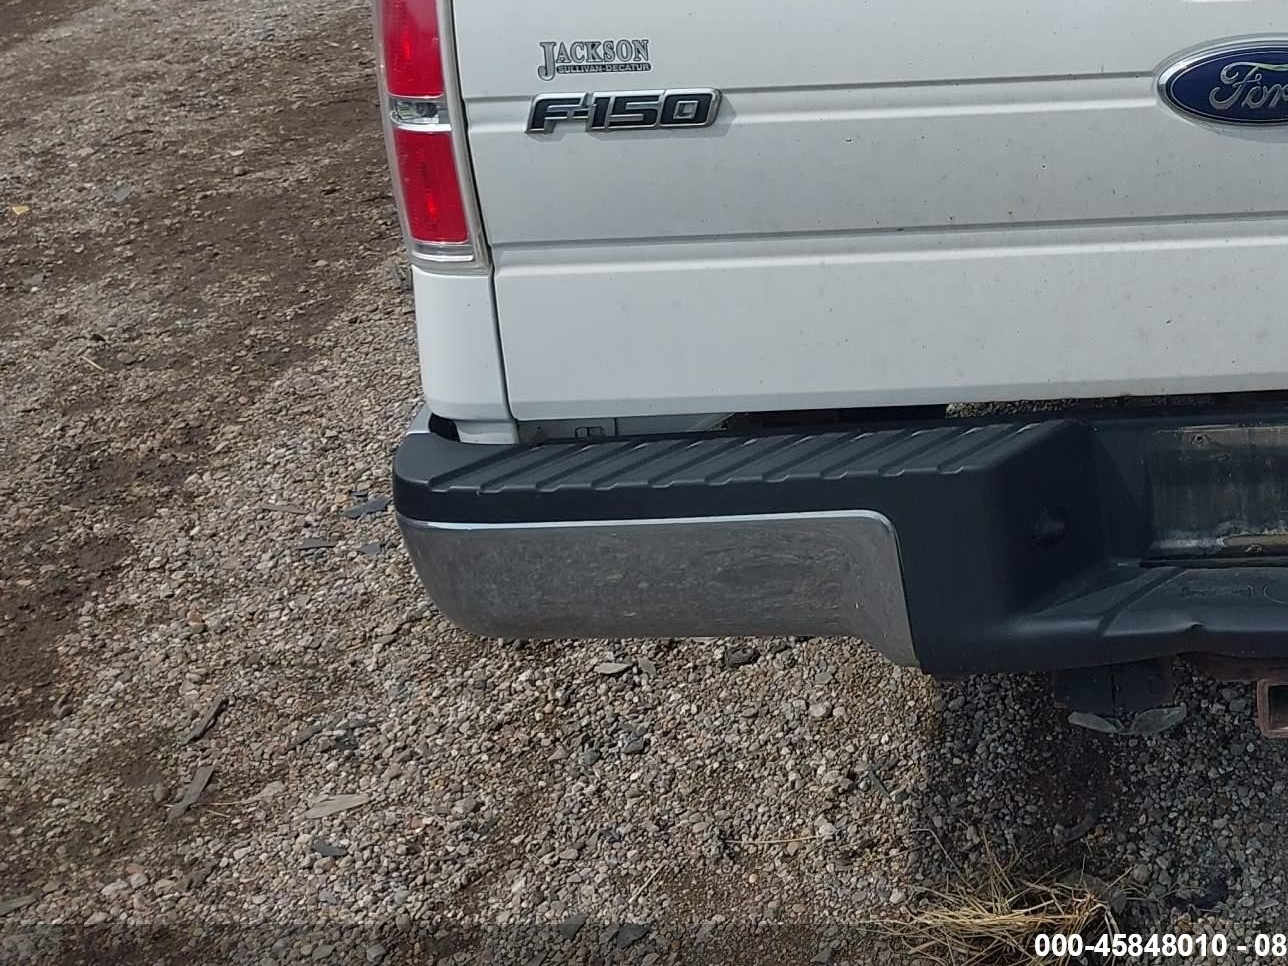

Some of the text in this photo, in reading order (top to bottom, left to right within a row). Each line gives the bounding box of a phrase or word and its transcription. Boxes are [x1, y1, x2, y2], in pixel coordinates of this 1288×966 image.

[538, 39, 650, 81] JACKSON
[558, 63, 650, 74] SULLIVAN-DECATUR
[525, 87, 722, 134] F-150
